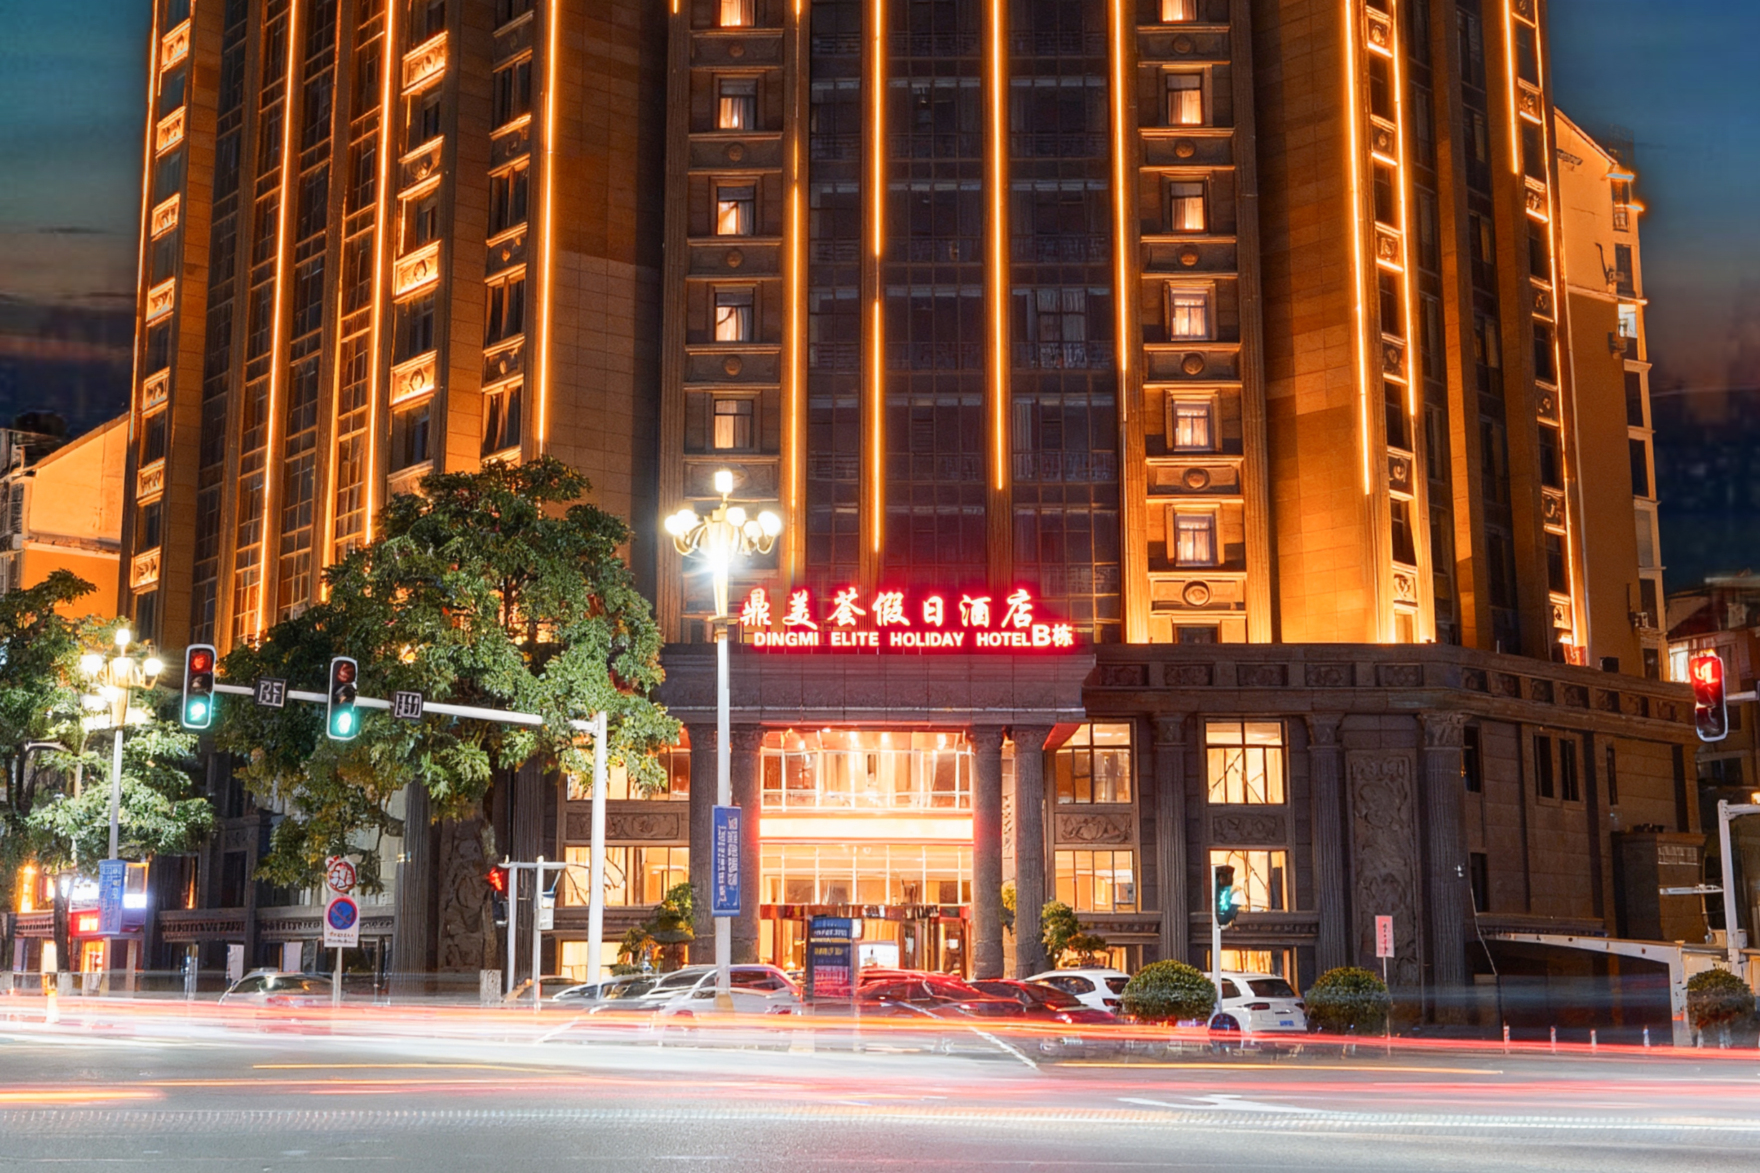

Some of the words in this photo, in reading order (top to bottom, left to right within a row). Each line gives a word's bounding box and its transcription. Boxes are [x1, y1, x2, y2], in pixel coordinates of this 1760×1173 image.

[753, 631, 819, 647] DINGMI
[830, 631, 880, 647] ELITE
[889, 631, 965, 647] HOLIDAY
[976, 631, 1031, 647] HOTEL
[1031, 623, 1074, 648] B栋
